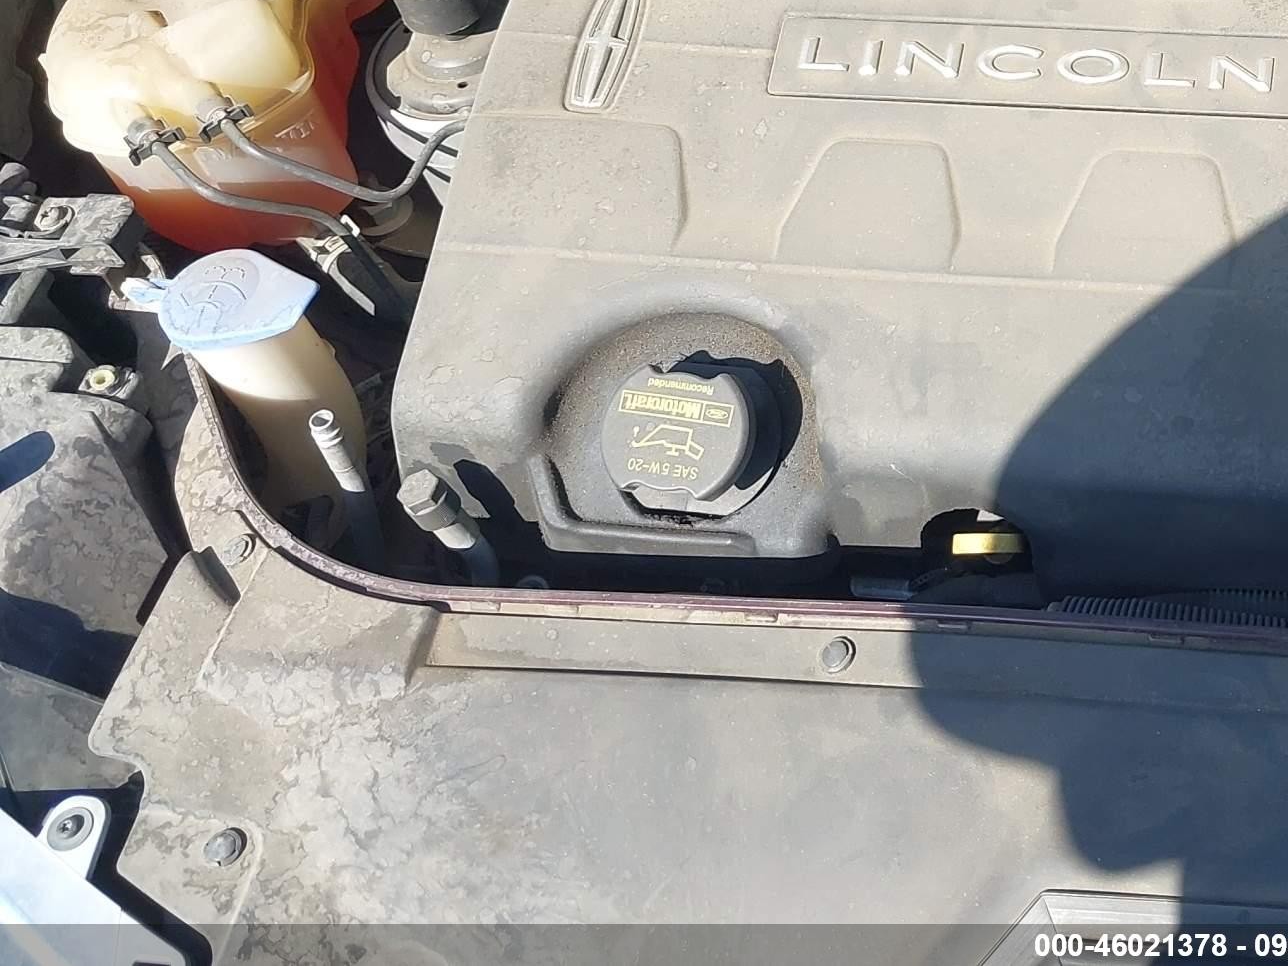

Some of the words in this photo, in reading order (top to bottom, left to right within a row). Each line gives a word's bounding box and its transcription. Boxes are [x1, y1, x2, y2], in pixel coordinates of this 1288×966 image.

[797, 35, 1275, 93] LINCOLN
[648, 377, 715, 396] Recommended
[624, 393, 701, 420] Motorcraft
[627, 457, 671, 475] 5W-20
[672, 465, 699, 480] SAE
